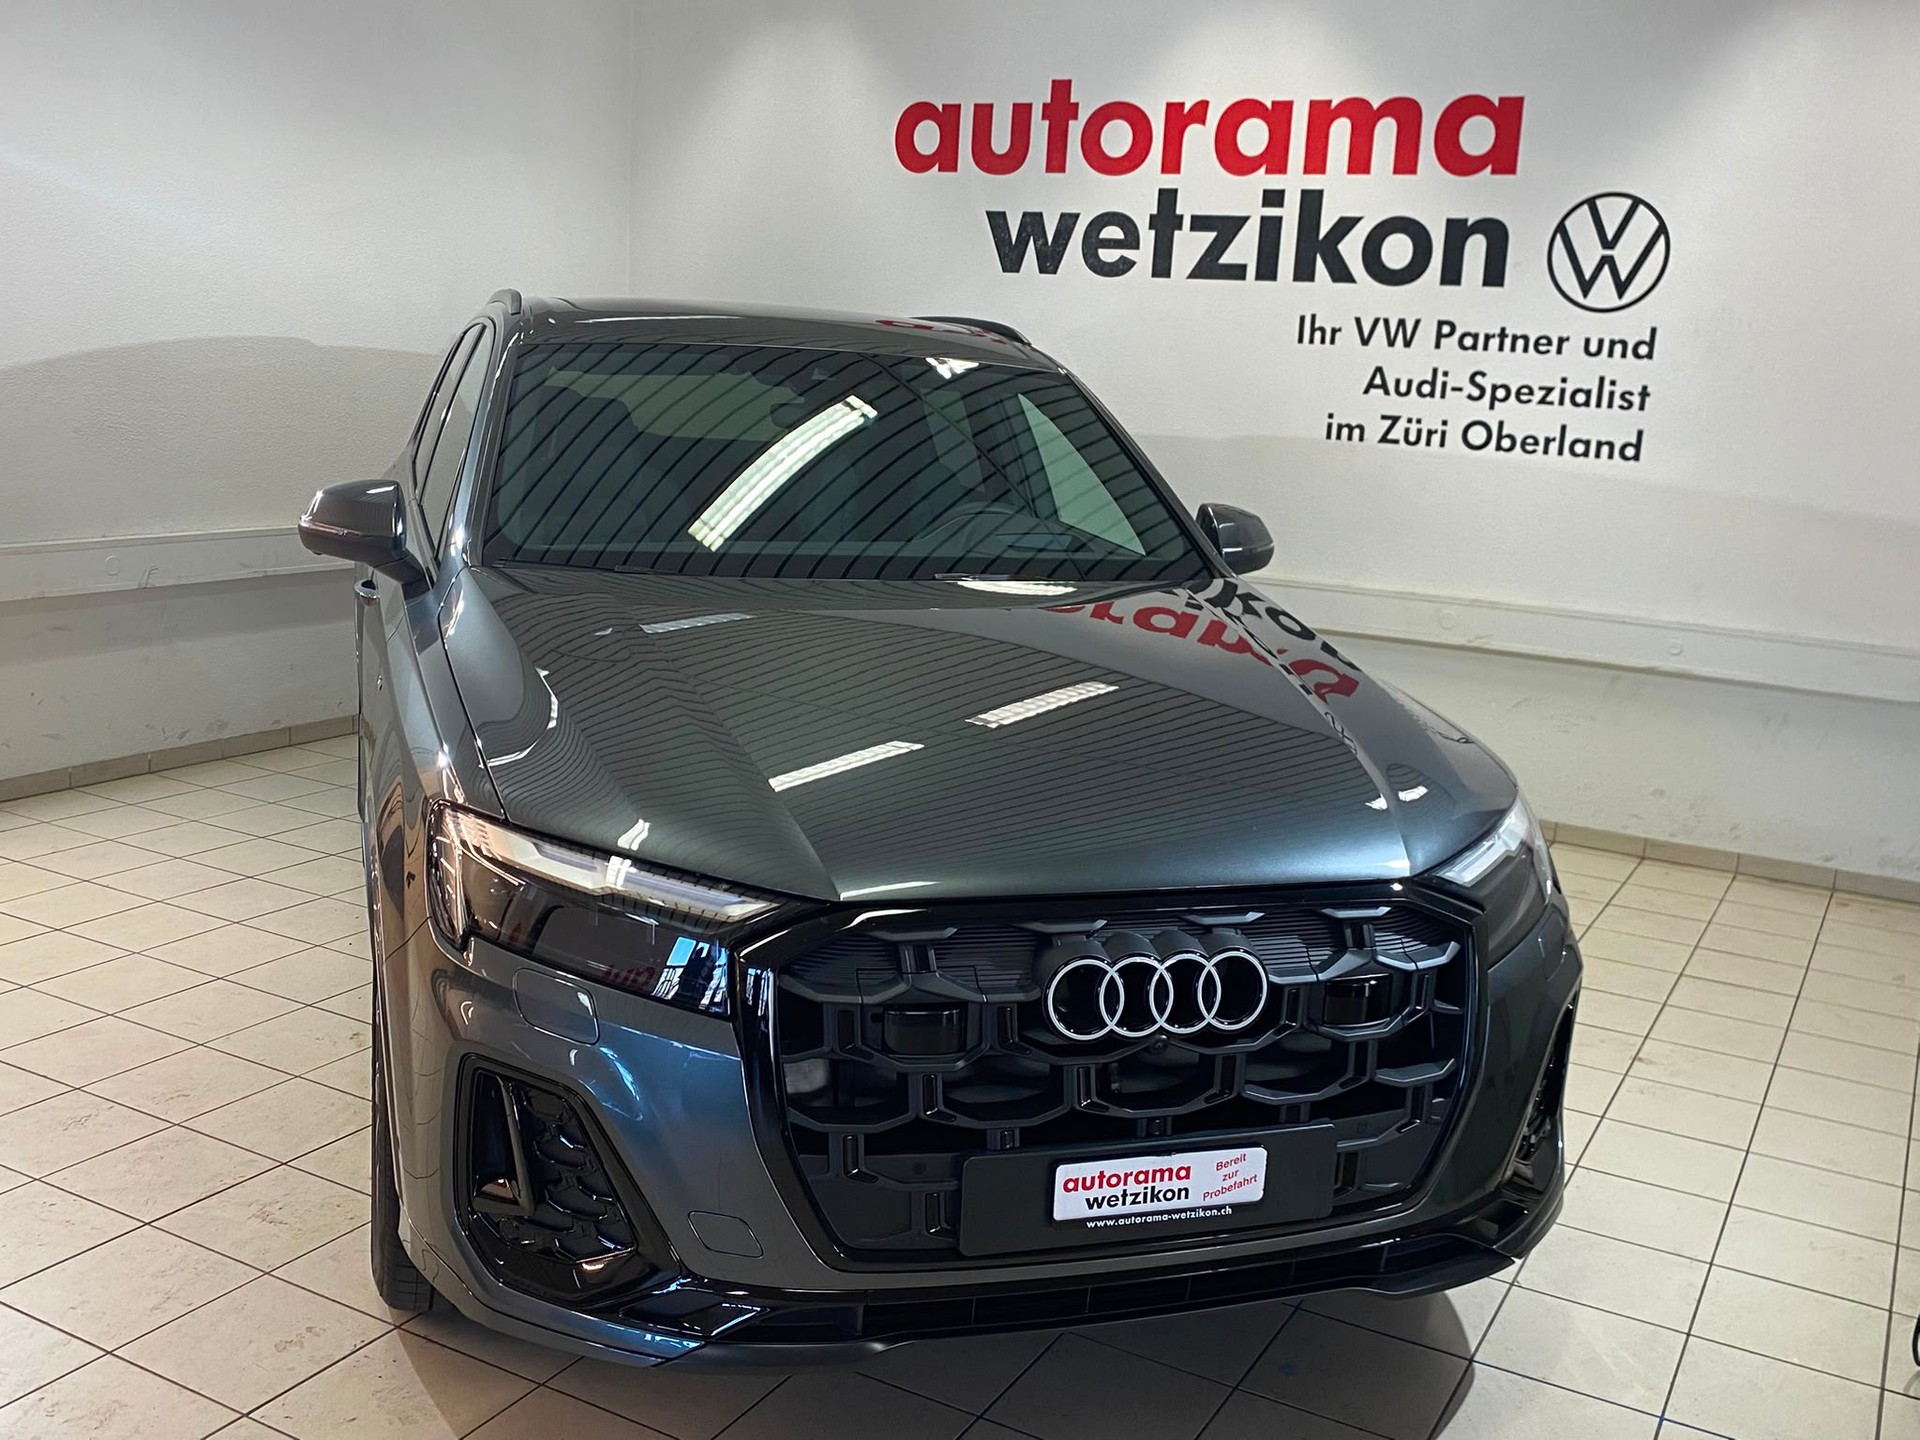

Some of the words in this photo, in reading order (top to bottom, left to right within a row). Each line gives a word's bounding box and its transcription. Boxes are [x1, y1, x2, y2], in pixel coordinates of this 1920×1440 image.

[894, 79, 1524, 177] autorama
[985, 187, 1509, 288] wetzikon
[1297, 314, 1347, 346] Ihr
[1354, 316, 1422, 349] VW
[1434, 319, 1570, 356] Partner
[1583, 326, 1657, 360] und
[1362, 366, 1651, 412] Audi-Spezialist
[1325, 412, 1365, 443] im
[1377, 414, 1448, 448] Züri
[1461, 420, 1644, 462] Oberland
[1215, 1152, 1247, 1171] Bereit
[1221, 1169, 1240, 1182] zur
[1062, 1165, 1192, 1193] autorama
[1202, 1173, 1258, 1202] Probefahrt
[1085, 1185, 1189, 1210] wetzikon
[1086, 1205, 1232, 1228] www.autorama-wetzikon.ch
